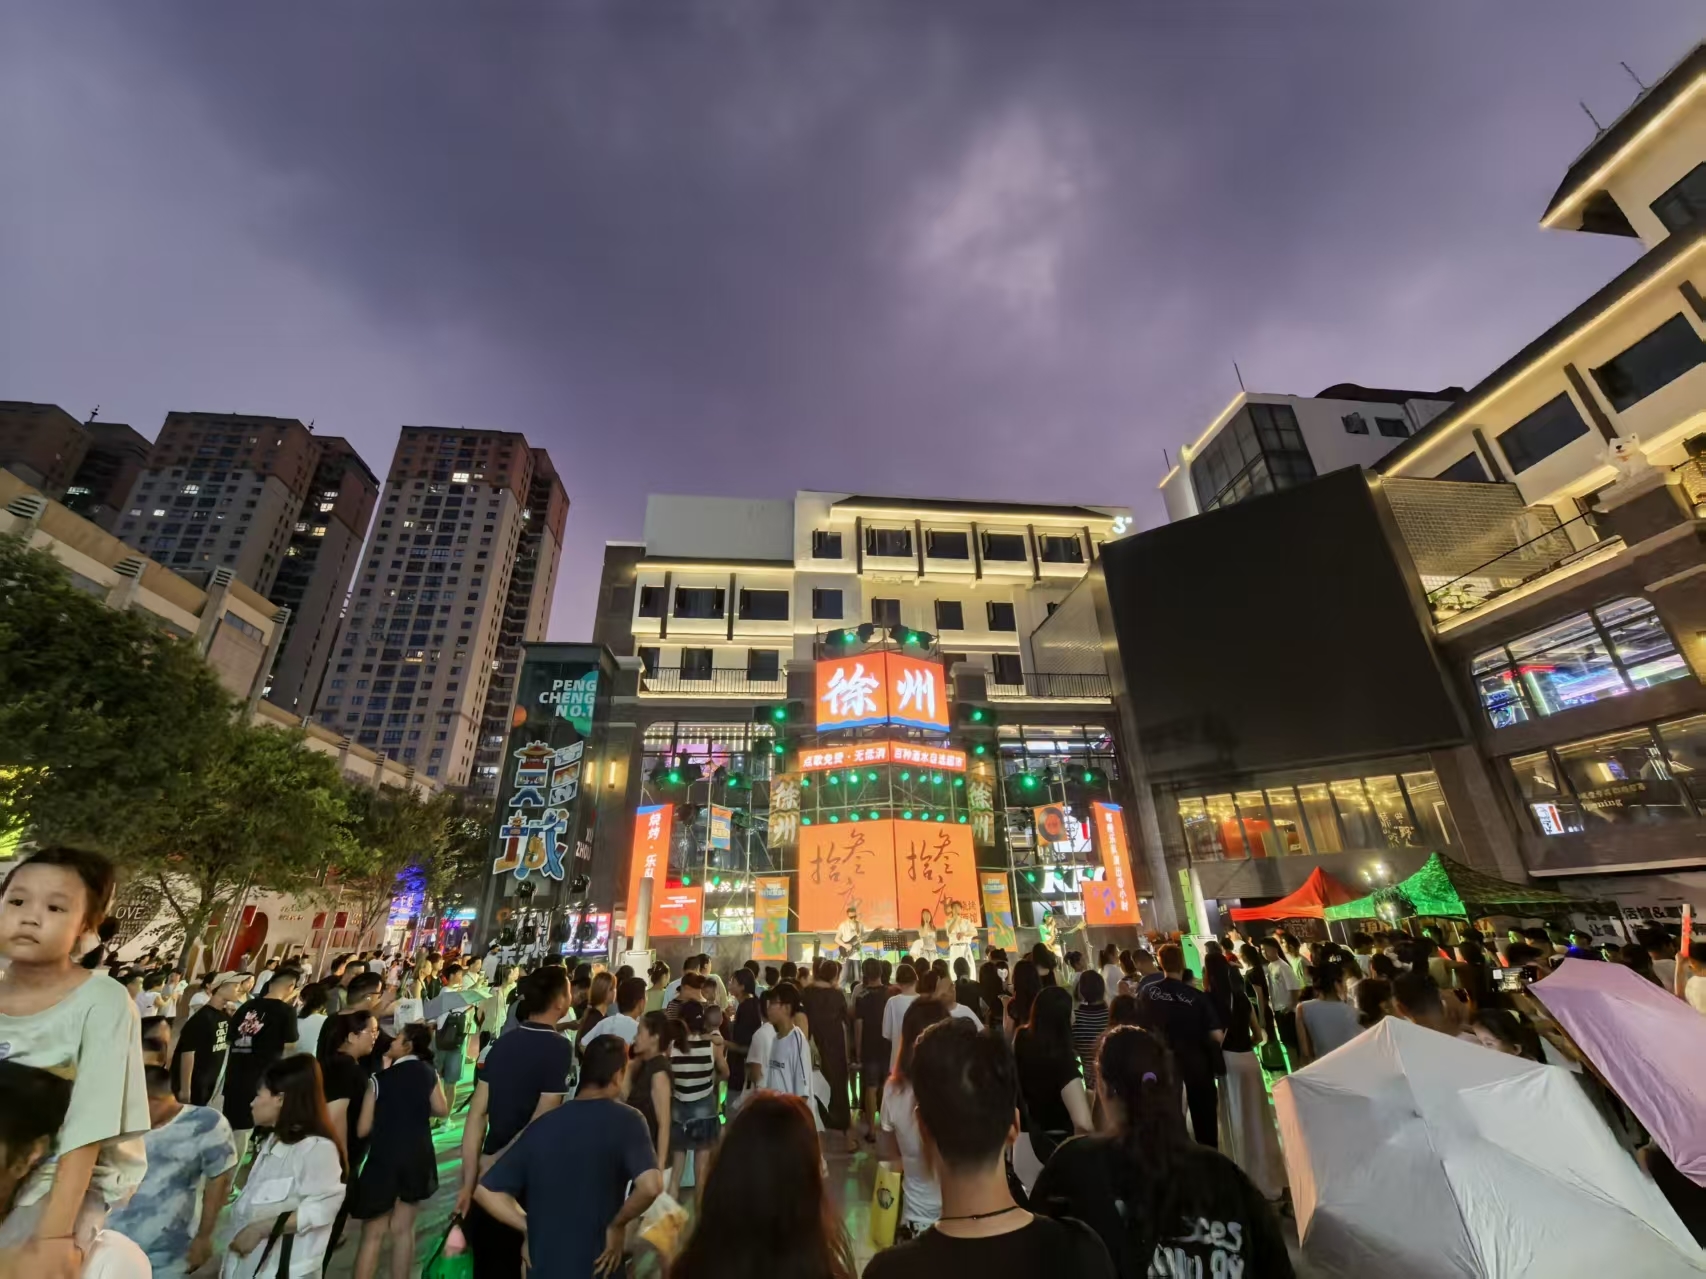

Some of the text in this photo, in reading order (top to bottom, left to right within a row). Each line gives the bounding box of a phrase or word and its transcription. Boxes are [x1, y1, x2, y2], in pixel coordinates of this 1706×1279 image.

[552, 680, 597, 691] PENG
[821, 663, 935, 718] 徐州
[539, 692, 596, 704] CHENG
[555, 705, 594, 717] NO.1
[803, 747, 886, 767] 点歌免费·无低消
[894, 748, 964, 767] 百种酒水自选超市
[774, 782, 800, 844] 徐州
[969, 782, 991, 842] 徐州
[644, 813, 661, 878] 烧烤·乐队
[115, 906, 145, 919] OVE
